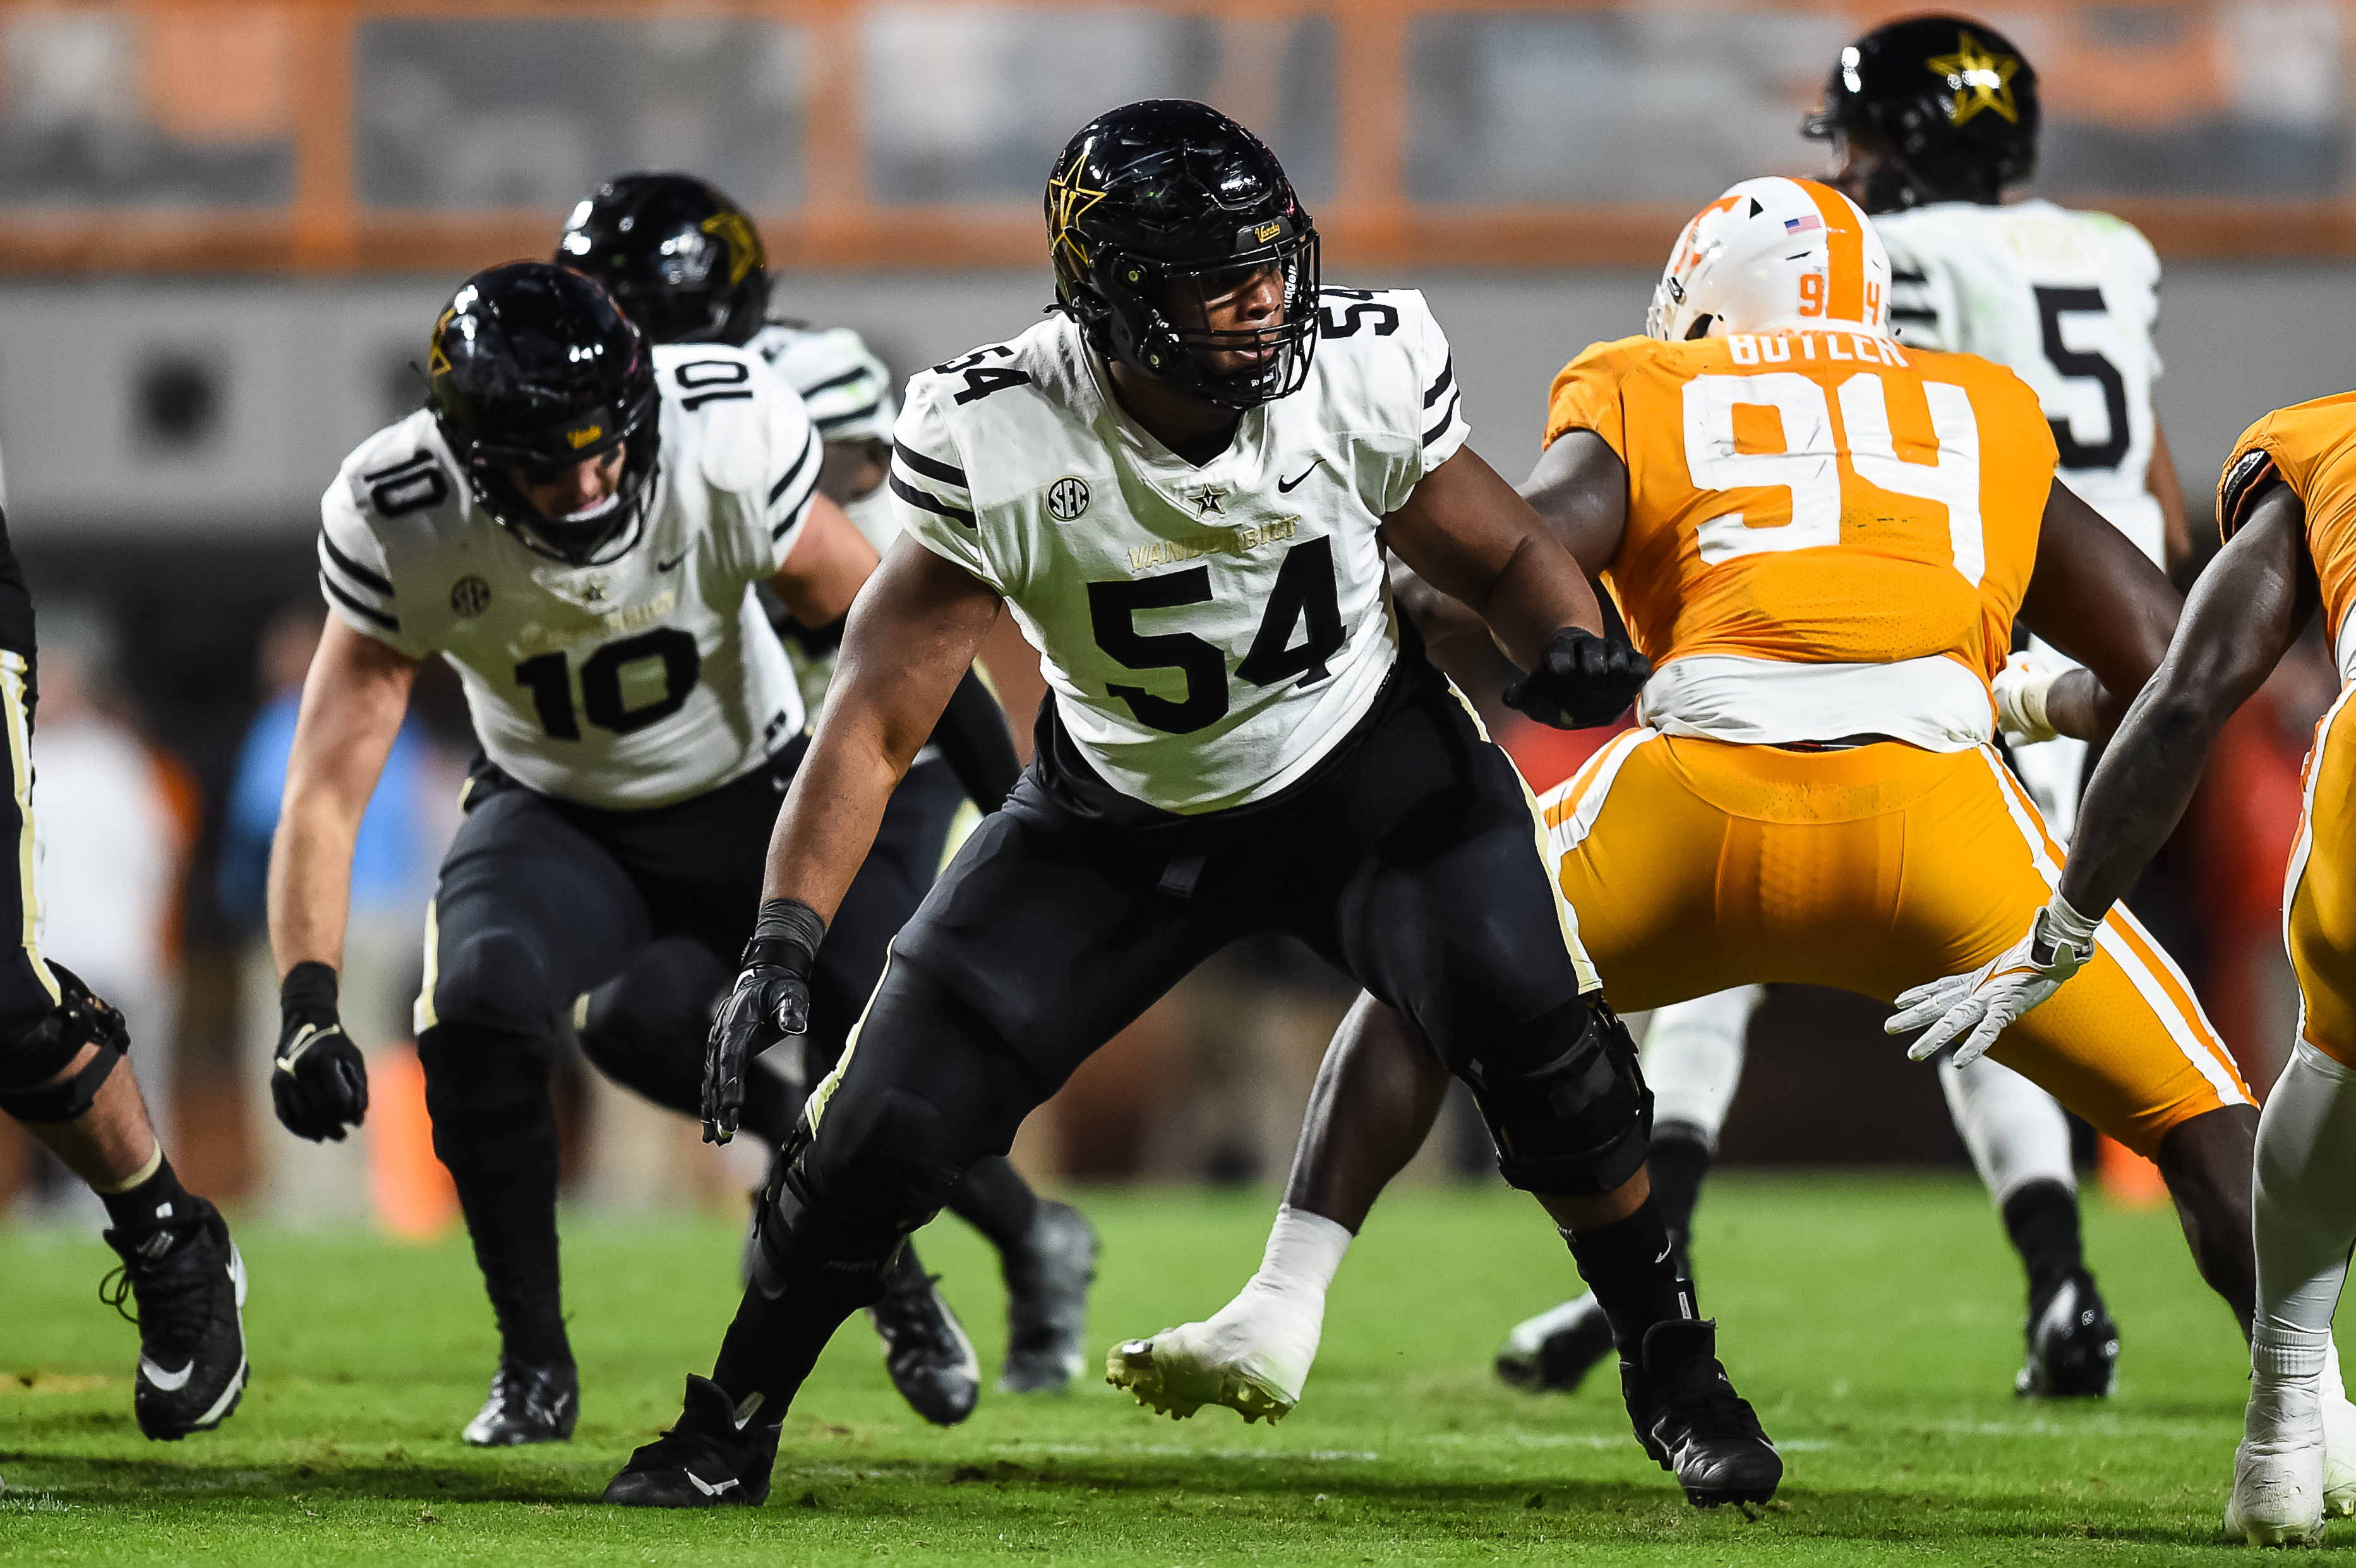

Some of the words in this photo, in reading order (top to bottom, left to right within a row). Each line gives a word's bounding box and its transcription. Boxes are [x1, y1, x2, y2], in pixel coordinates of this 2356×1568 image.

[1254, 222, 1281, 243] Vandy
[932, 345, 1033, 406] 54
[1728, 334, 1909, 368] BUTLER
[2032, 284, 2131, 470] 5
[674, 360, 753, 412] 10
[363, 448, 448, 520] 10
[1050, 479, 1088, 518] SEC
[1681, 371, 1986, 590] 94
[1086, 534, 1348, 735] 54
[515, 625, 700, 742] 10
